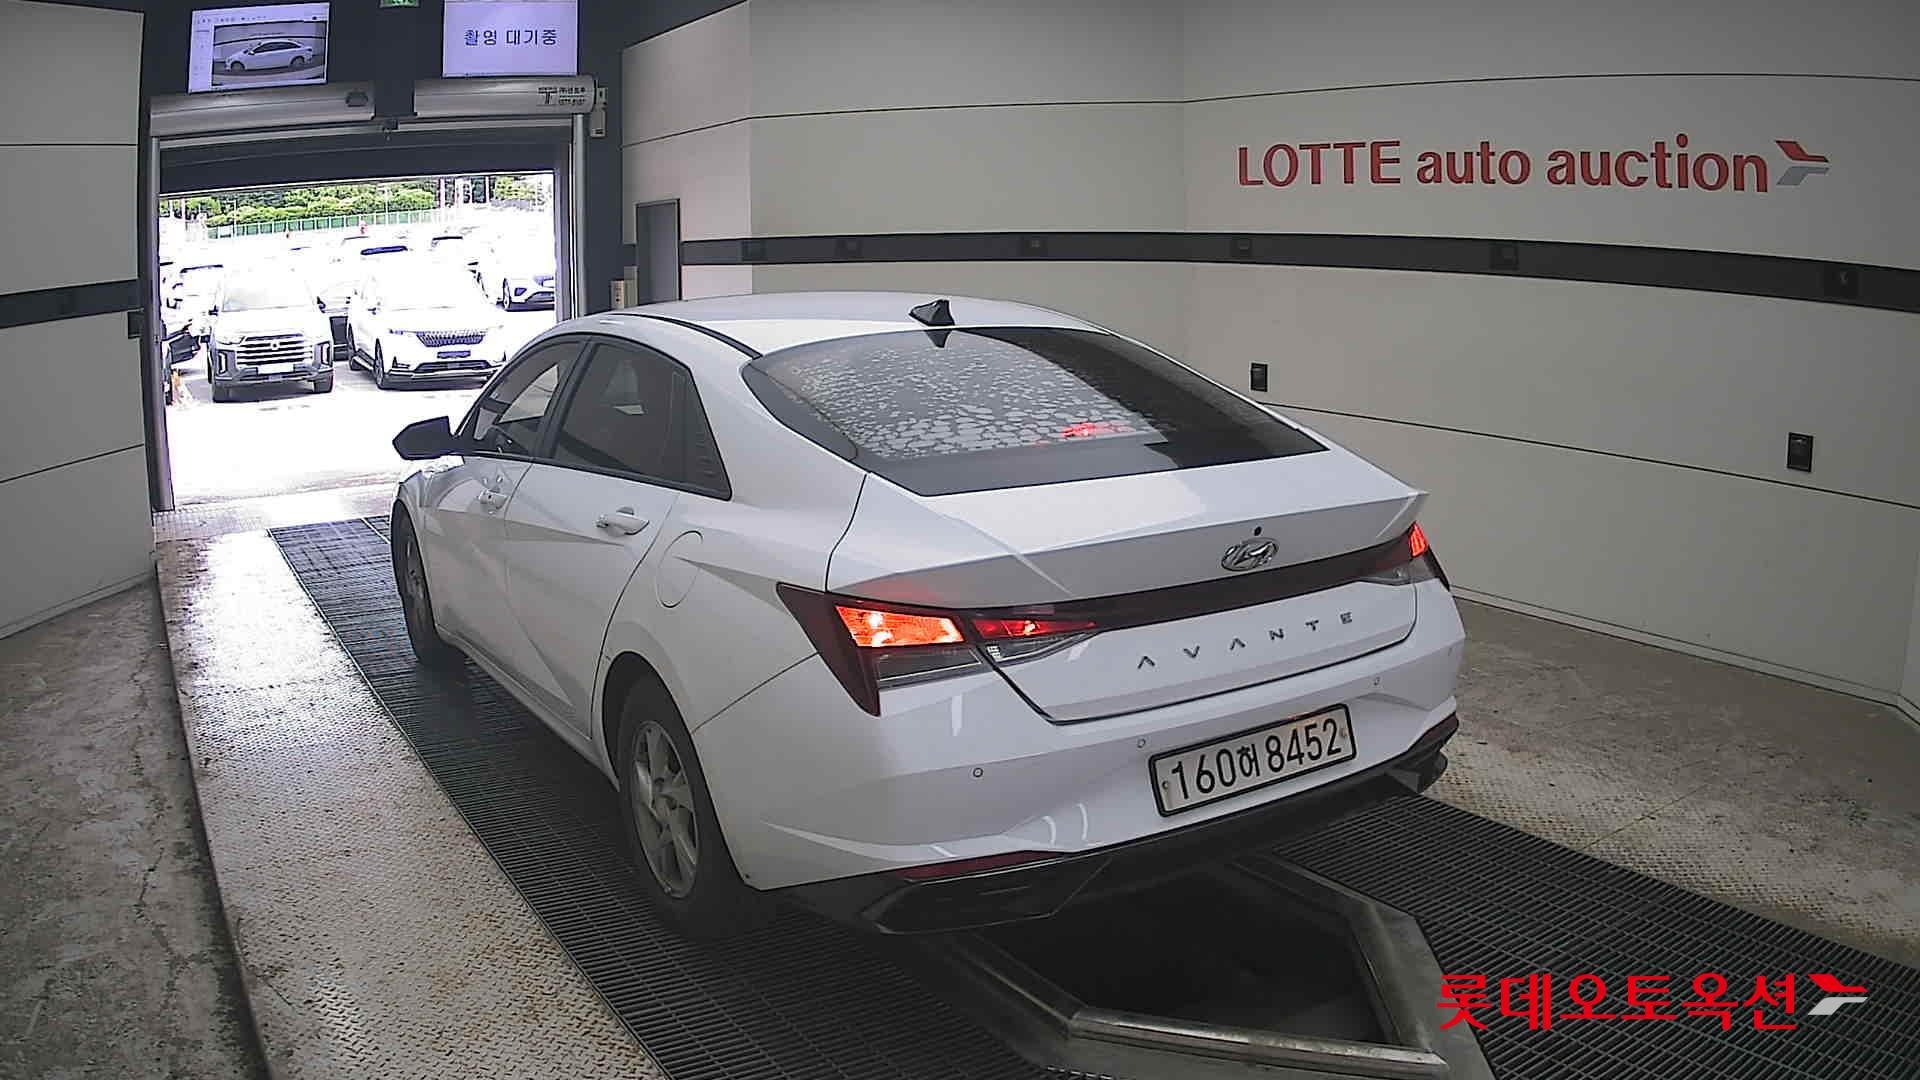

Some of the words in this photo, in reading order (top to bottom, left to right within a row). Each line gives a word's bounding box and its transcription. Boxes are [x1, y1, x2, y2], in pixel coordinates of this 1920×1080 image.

[464, 29, 497, 46] 촬영
[506, 29, 557, 46] 대기중
[1239, 141, 1400, 188] LOTTE
[1417, 140, 1531, 185] auto
[1548, 133, 1768, 193] auction
[1138, 612, 1353, 669] AVANTE
